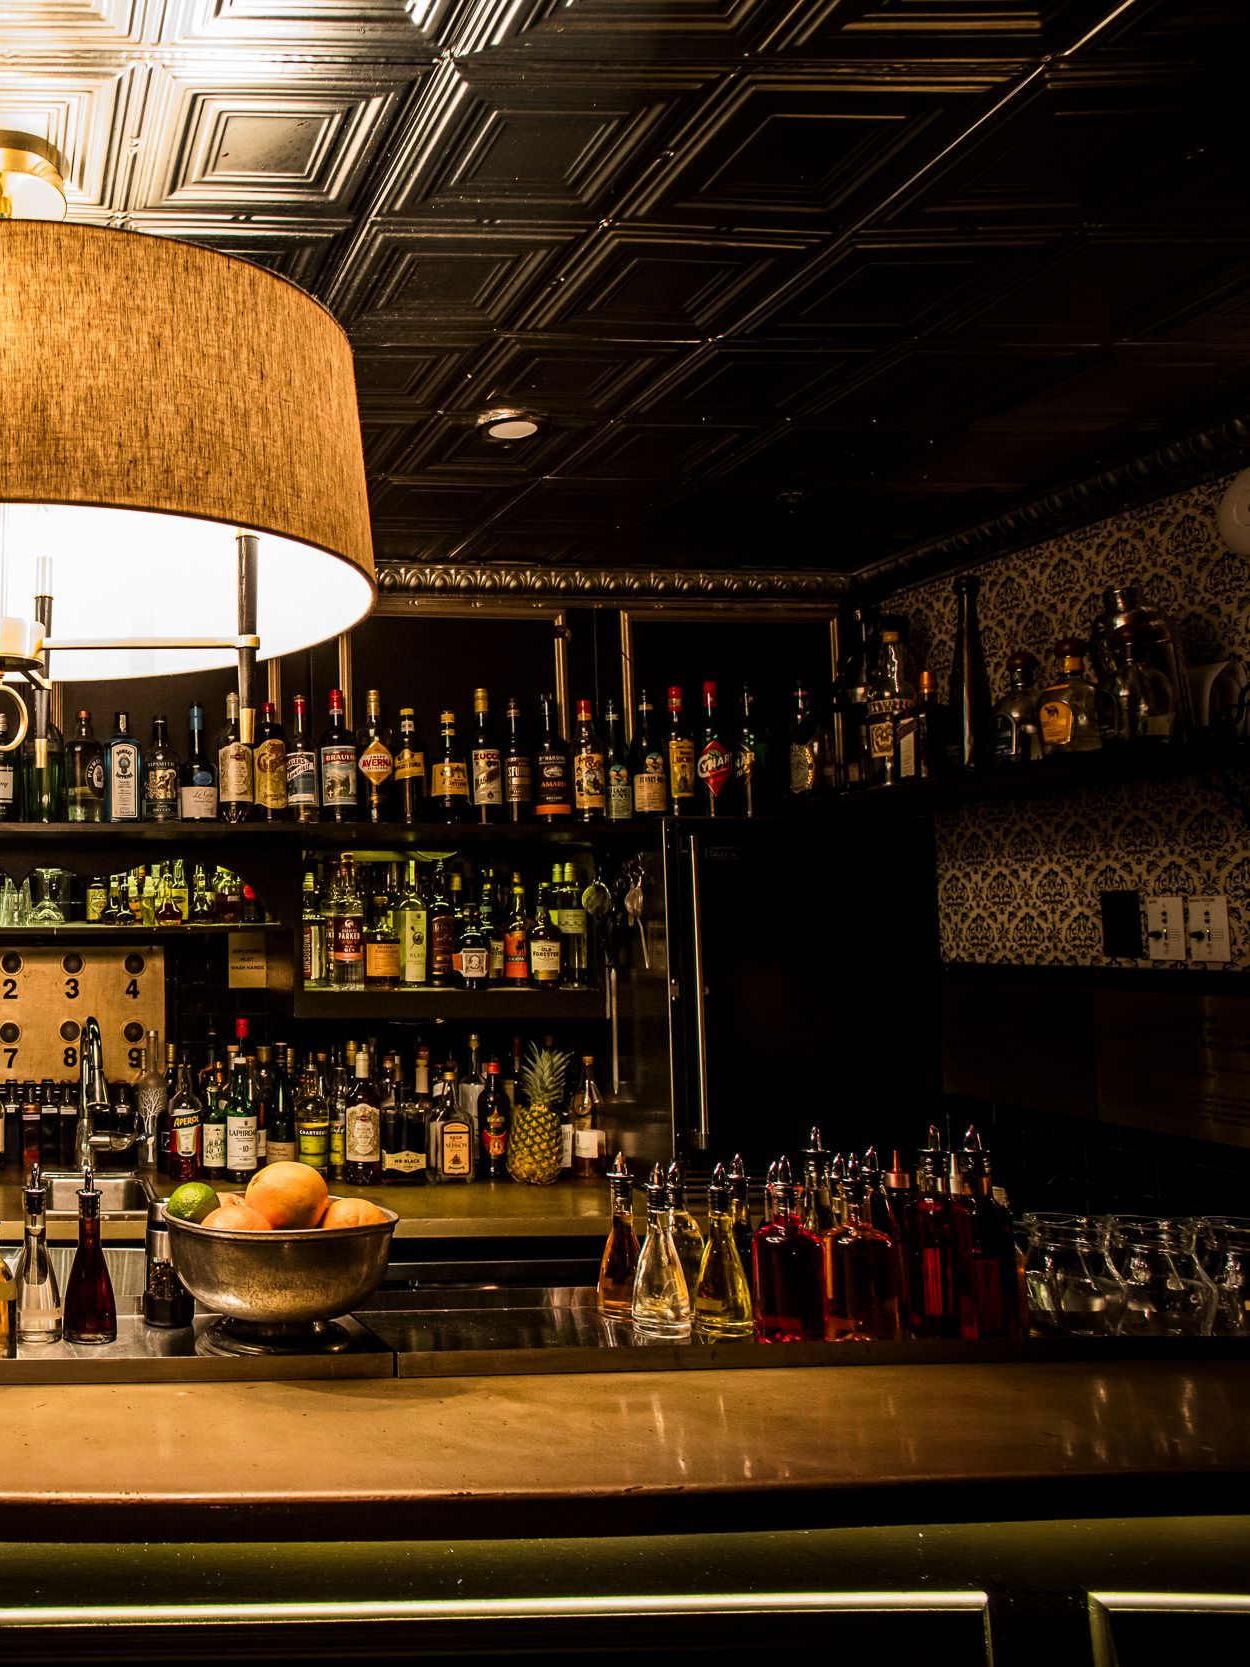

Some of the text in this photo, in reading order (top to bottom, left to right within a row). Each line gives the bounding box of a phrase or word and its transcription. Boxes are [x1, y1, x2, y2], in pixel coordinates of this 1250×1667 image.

[473, 752, 498, 760] ZUCC
[362, 758, 391, 768] AVERNA
[697, 753, 730, 778] CYNAR
[338, 932, 361, 940] PARKER
[303, 933, 311, 973] LUKSUSOWA
[3, 979, 18, 999] 2
[65, 978, 79, 999] 3
[125, 979, 140, 999] 4
[3, 1048, 18, 1068] 7
[63, 1048, 77, 1068] 8
[128, 1048, 141, 1068] 9
[173, 1116, 199, 1128] APEROL
[229, 1129, 257, 1137] LAPHROA
